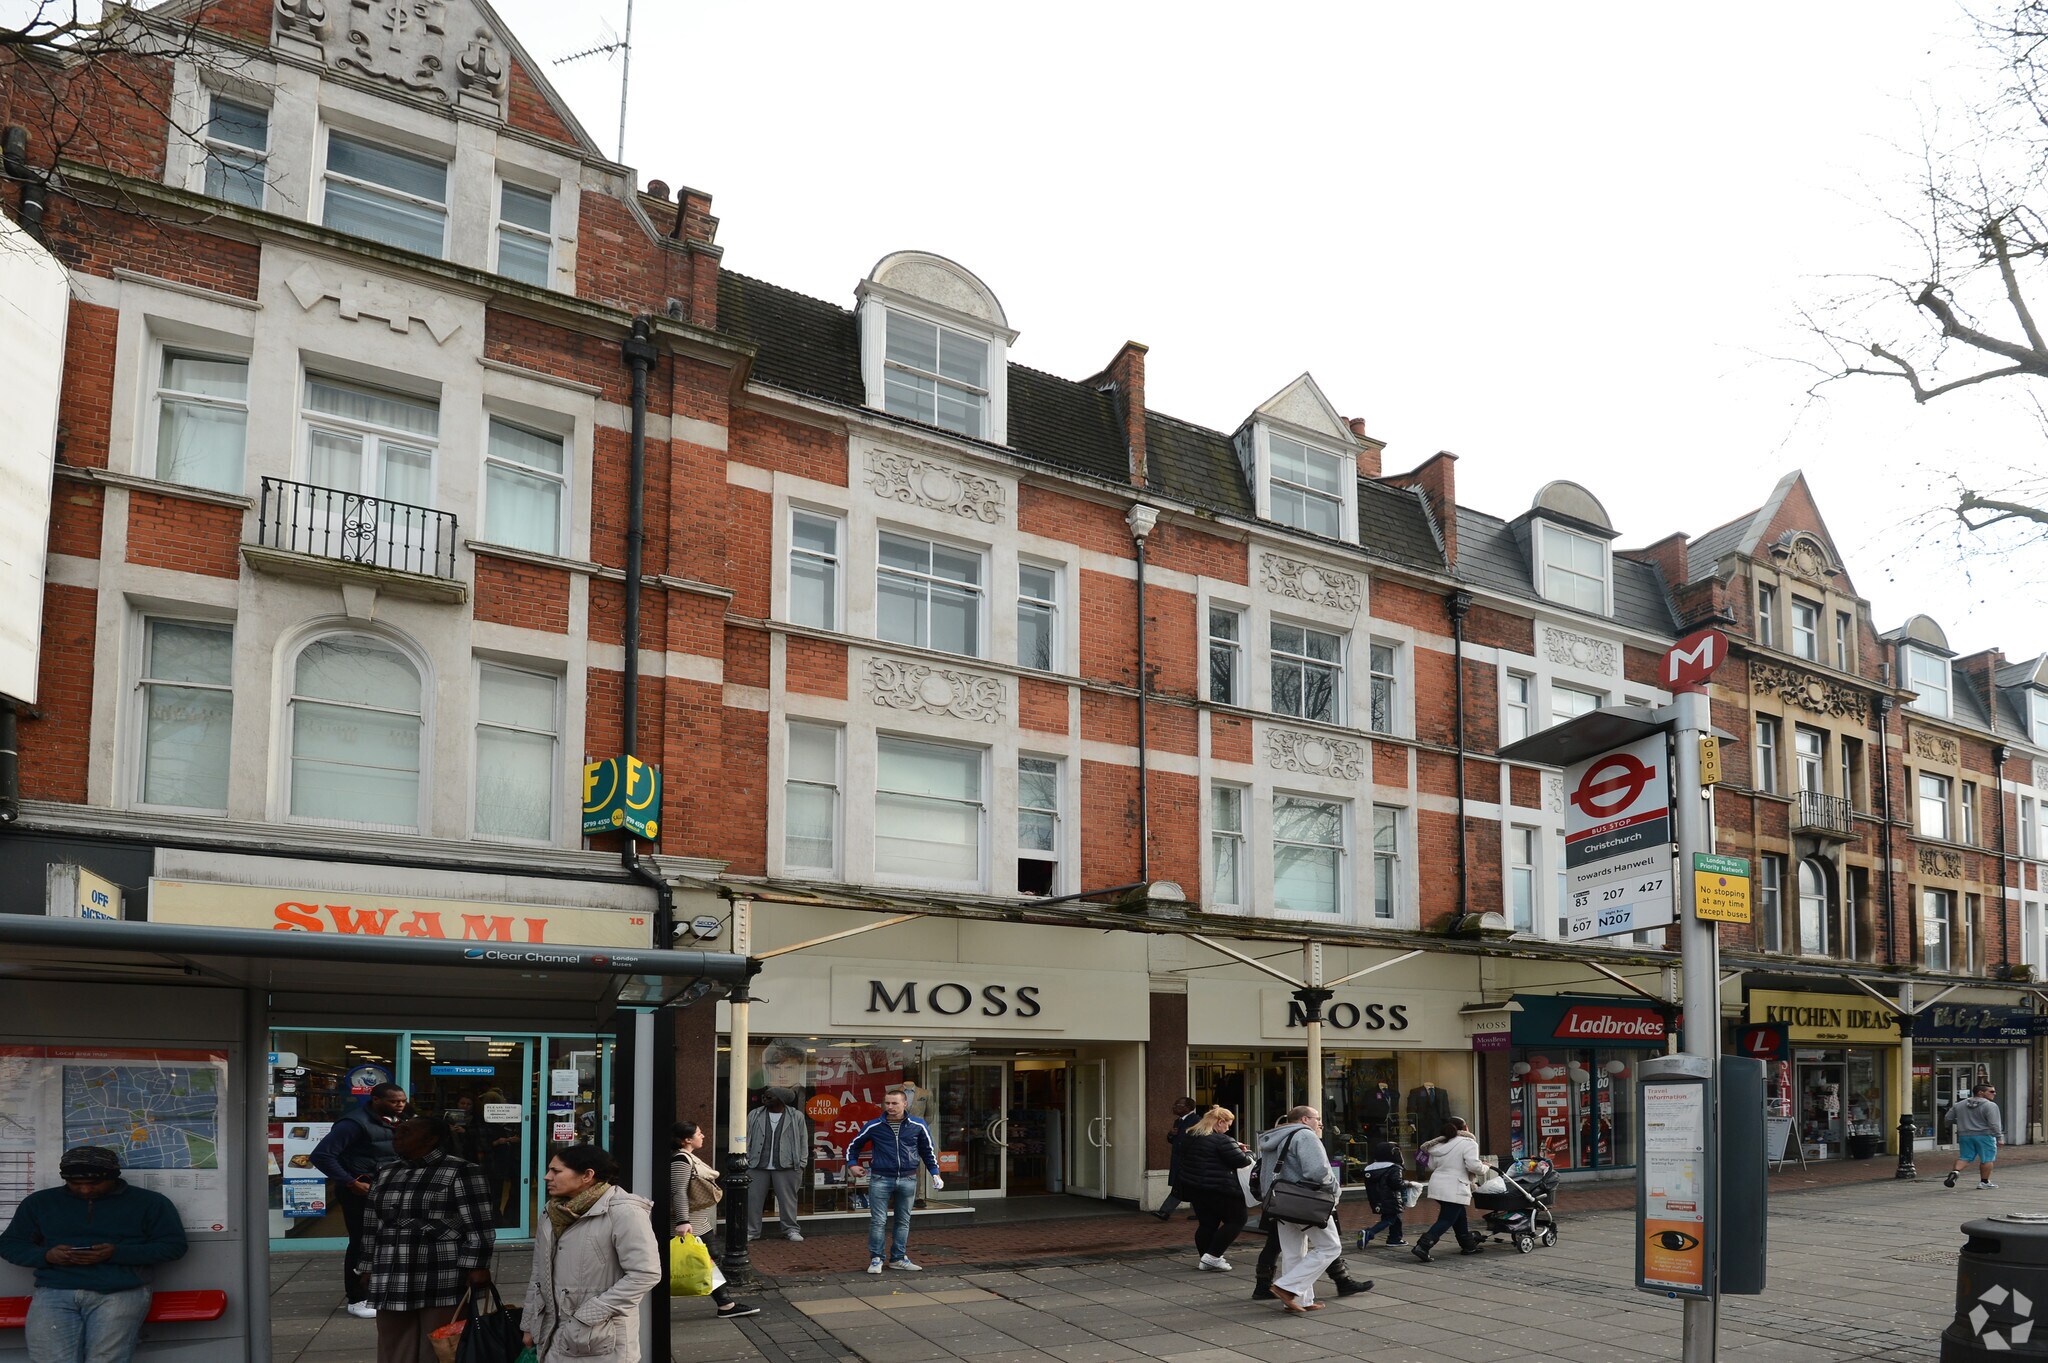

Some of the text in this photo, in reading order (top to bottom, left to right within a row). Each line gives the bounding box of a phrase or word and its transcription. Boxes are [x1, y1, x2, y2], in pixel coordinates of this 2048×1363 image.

[1669, 635, 1714, 682] M
[1591, 818, 1632, 835] BUS STOP
[1584, 832, 1642, 854] Christchurch
[1700, 862, 1744, 874] Priority Network
[1706, 857, 1725, 865] London
[1577, 856, 1655, 882] towards Hanwell
[1638, 879, 1663, 893] 427
[1701, 885, 1745, 899] No stopping
[91, 889, 109, 907] OFF
[1603, 887, 1625, 901] 207
[1575, 896, 1588, 908] 83
[1702, 897, 1745, 909] at any time
[1598, 912, 1631, 928] N207
[1700, 908, 1748, 919] except buses
[1572, 920, 1592, 933] 607
[486, 950, 525, 962] Clear
[527, 952, 580, 964] Channel
[866, 980, 1042, 1017] MOSS
[1569, 1013, 1664, 1036] Ladbrokes
[1766, 1005, 1892, 1030] KITCHEN IDEAS
[1476, 1021, 1507, 1030] MOSS
[2000, 1028, 2027, 1036] OPTICIANS
[1753, 1031, 1770, 1052] L
[816, 1099, 832, 1107] MID
[808, 1107, 839, 1115] SEASON
